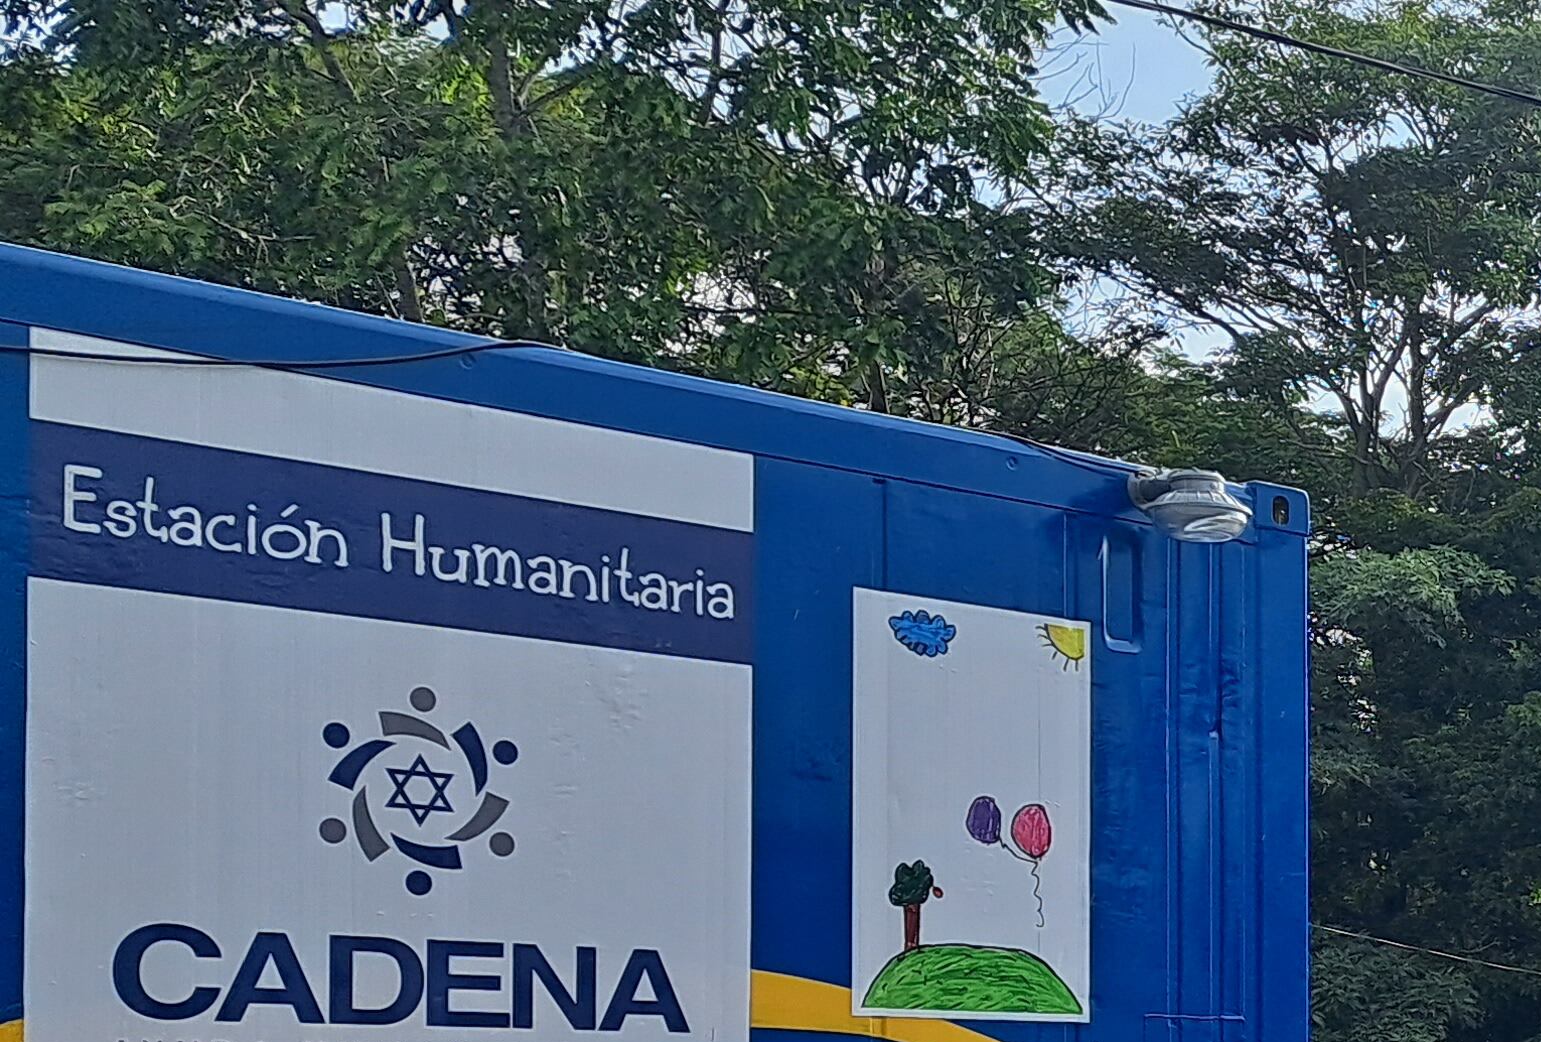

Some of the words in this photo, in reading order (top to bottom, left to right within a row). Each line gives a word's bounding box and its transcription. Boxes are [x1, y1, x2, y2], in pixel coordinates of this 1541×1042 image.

[63, 464, 349, 568] Estación
[381, 511, 736, 619] Humanitaria
[112, 923, 691, 1033] CADENA
